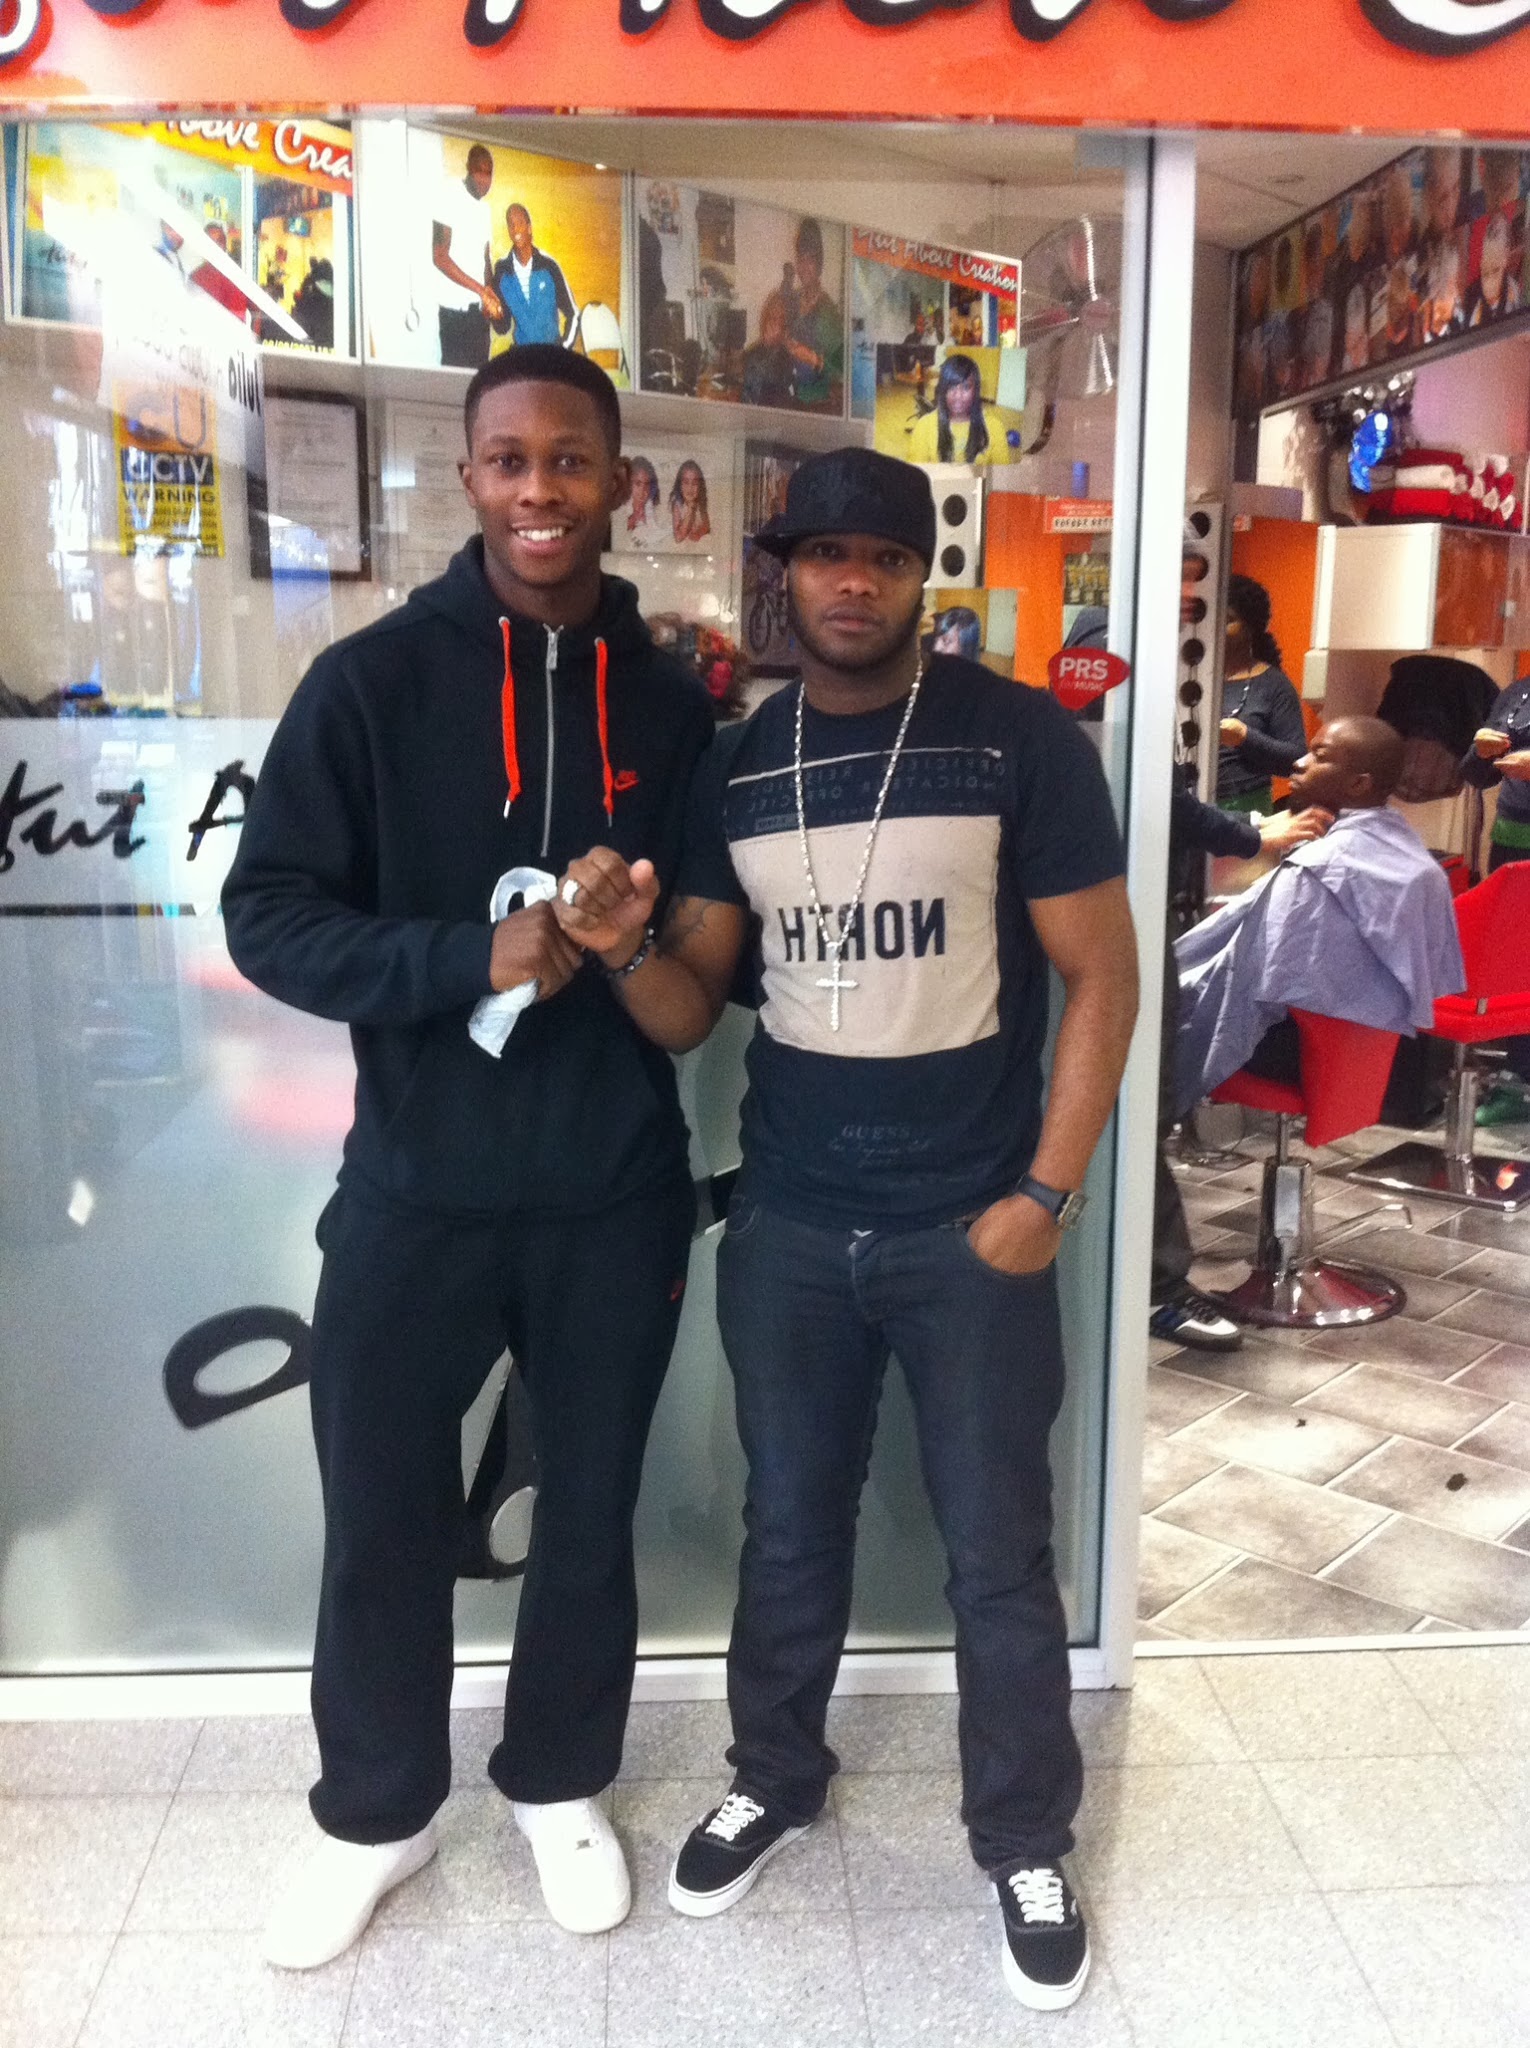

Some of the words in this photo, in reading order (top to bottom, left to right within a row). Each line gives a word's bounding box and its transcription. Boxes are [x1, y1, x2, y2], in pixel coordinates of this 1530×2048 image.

[127, 450, 210, 484] CCTV
[123, 487, 216, 503] WARNING
[1059, 656, 1109, 680] PRS
[841, 1124, 911, 1140] GUESS
